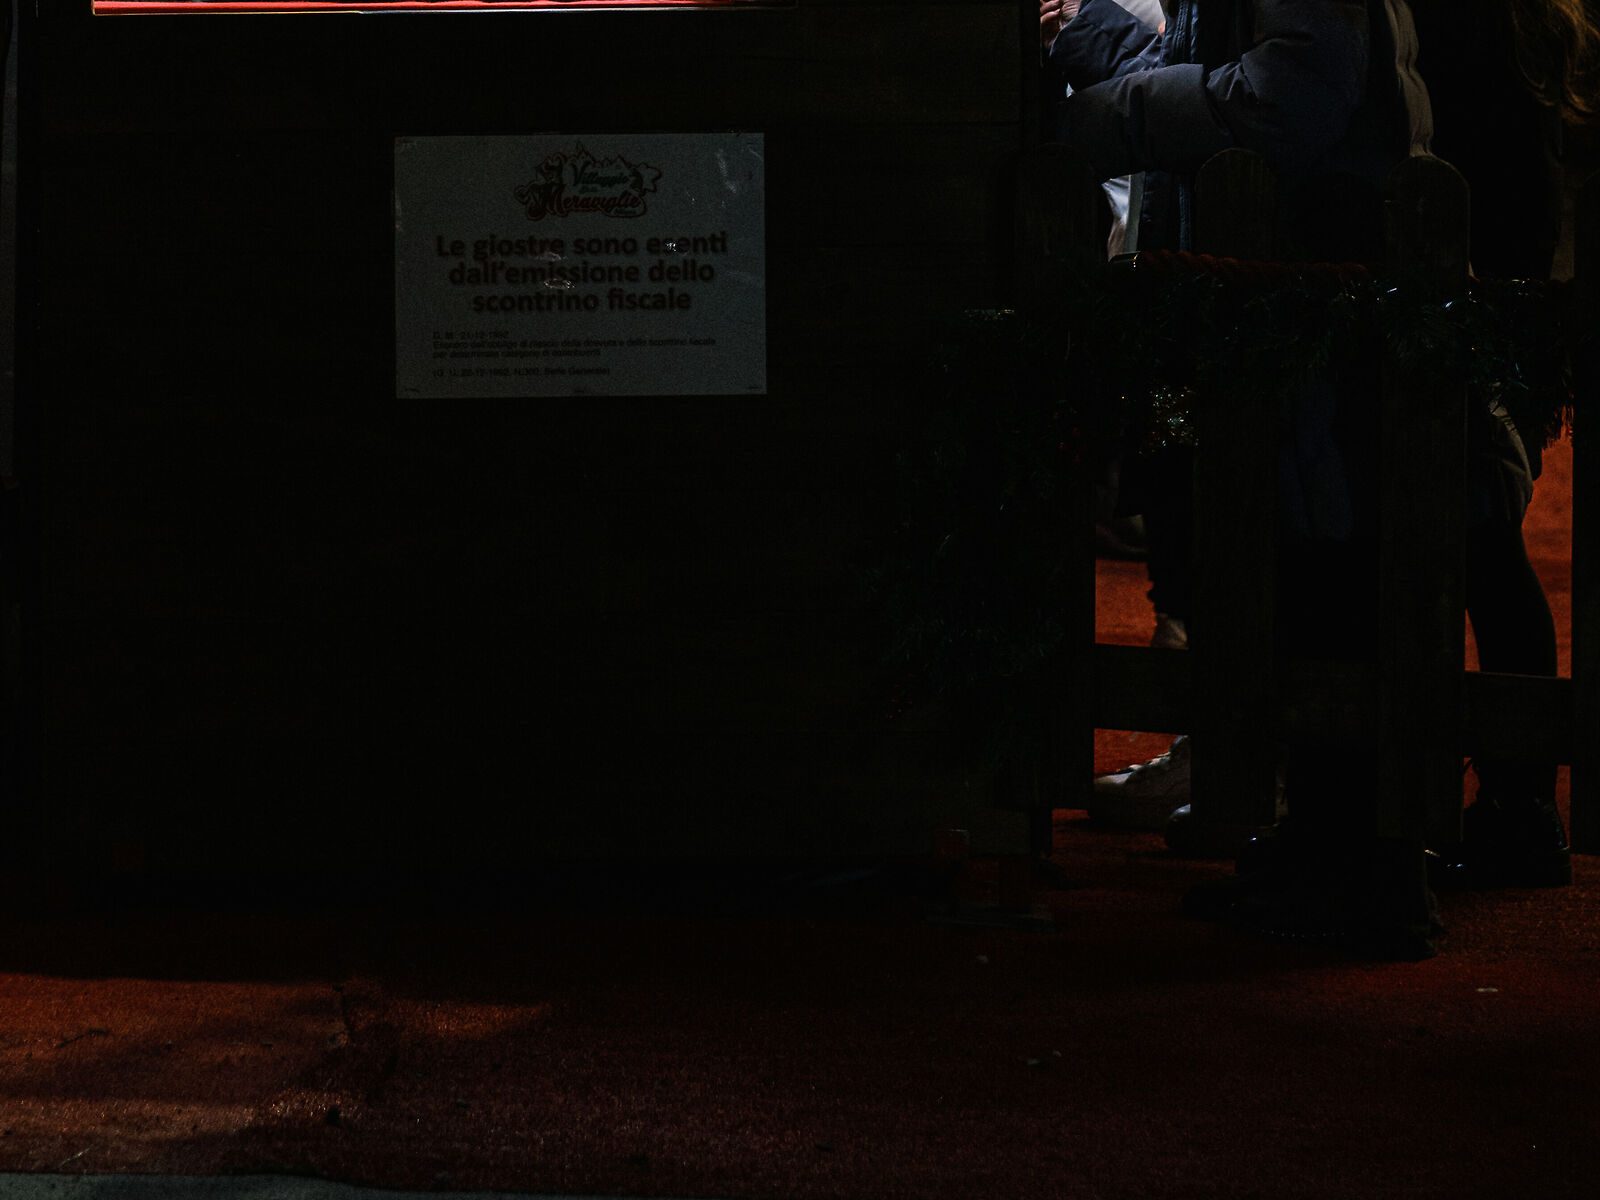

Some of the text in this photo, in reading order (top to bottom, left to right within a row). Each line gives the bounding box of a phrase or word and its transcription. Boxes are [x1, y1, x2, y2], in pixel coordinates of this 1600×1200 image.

[436, 235, 466, 256] Le
[472, 235, 565, 261] giostre
[573, 237, 638, 255] sono
[647, 258, 716, 282] dello
[472, 287, 692, 313] scontrino fiscale
